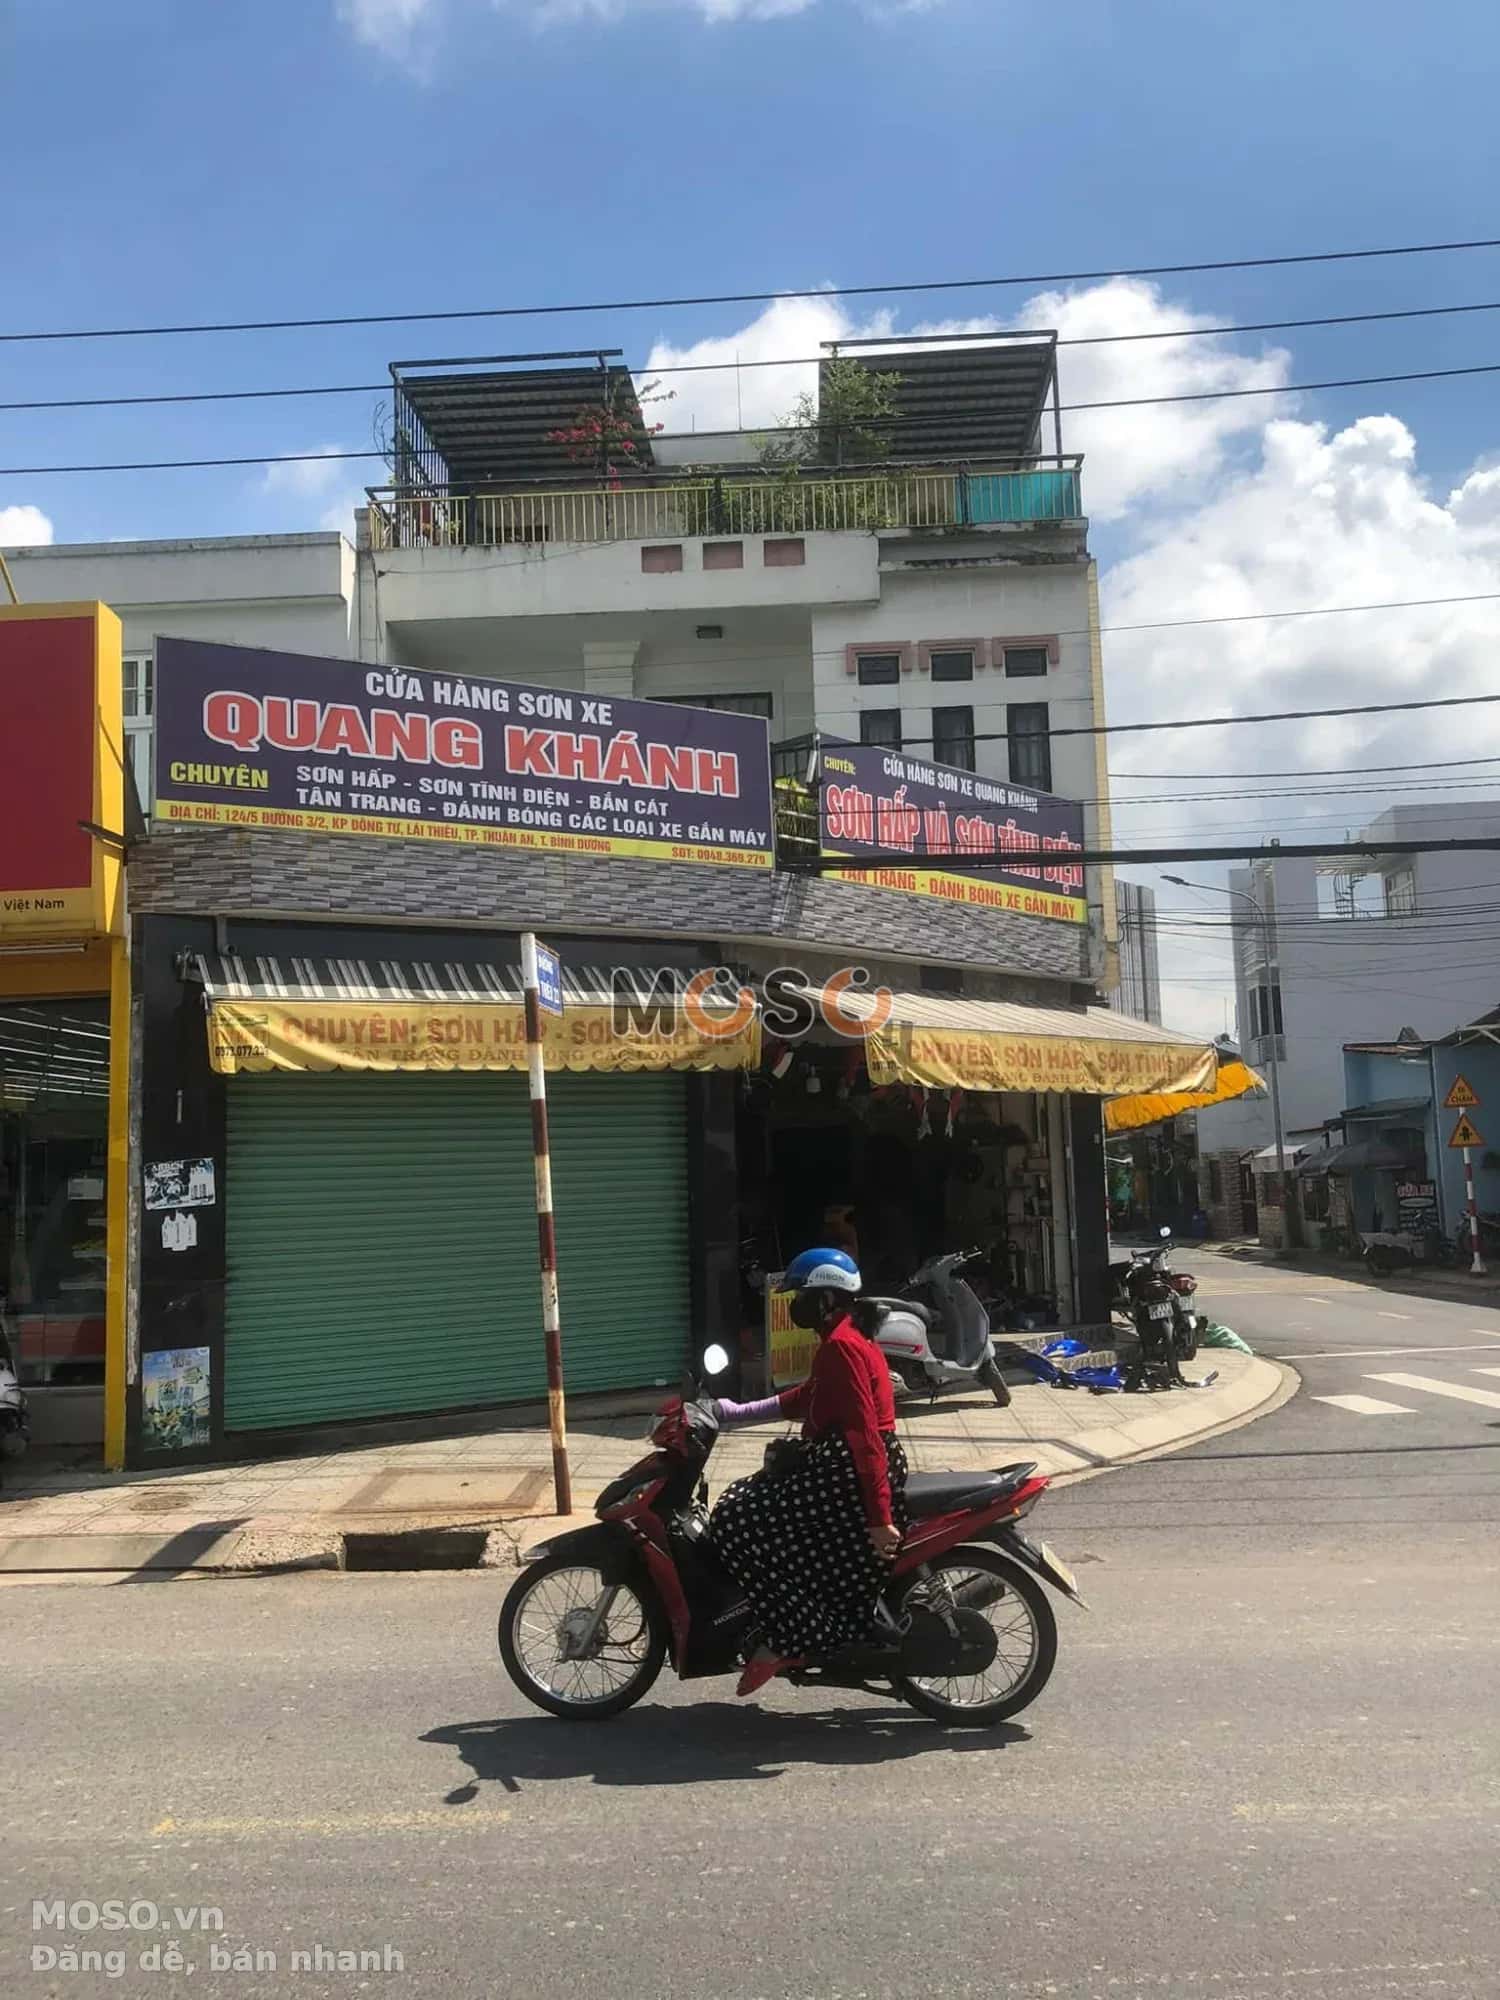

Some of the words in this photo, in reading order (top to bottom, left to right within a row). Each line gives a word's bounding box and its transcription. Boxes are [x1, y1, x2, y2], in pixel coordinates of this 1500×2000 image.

[365, 667, 424, 702] CỬA
[433, 679, 509, 713] HÀNG
[518, 692, 573, 721] SƠN
[581, 700, 613, 726] XE
[203, 690, 483, 769] QUANG
[504, 725, 740, 798] KHÁNH
[170, 761, 269, 788] CHUYÊN
[296, 765, 344, 785] SƠN
[351, 767, 396, 789] HẤP
[419, 777, 463, 796] SƠN
[469, 780, 517, 802] TĨNH
[523, 787, 570, 809] ĐIỆN
[589, 791, 628, 813] BẮN
[634, 798, 669, 817] CÁT
[883, 754, 904, 778] CỬA
[907, 761, 935, 787] HÀNG
[937, 772, 958, 793] SƠN
[961, 777, 973, 797] XE
[975, 781, 1007, 805] QUANG
[170, 804, 192, 819] ĐỊA
[332, 816, 348, 829] KP
[296, 786, 341, 807] TÂN
[348, 792, 421, 814] TRANG
[443, 800, 501, 822] ĐÁNH
[508, 806, 562, 827] BÓNG
[568, 812, 607, 832] CÁC
[613, 817, 653, 838] LOẠI
[660, 822, 682, 838] XE
[688, 821, 724, 842] GẮN
[730, 828, 767, 846] MÁY
[826, 784, 874, 845] SƠN
[877, 783, 921, 853] HẤP
[923, 800, 952, 856] VÀ
[955, 815, 996, 856] SƠN
[4, 899, 30, 912] Việt
[35, 899, 64, 909] Nam
[929, 876, 965, 900] ĐÁNH
[969, 884, 1002, 906] BÓNG
[1006, 891, 1021, 909] XE
[282, 1012, 418, 1044] CHUYÊN:
[427, 1014, 483, 1044] SƠN
[1003, 1042, 1042, 1068] SƠN
[1097, 1049, 1131, 1073] SƠN
